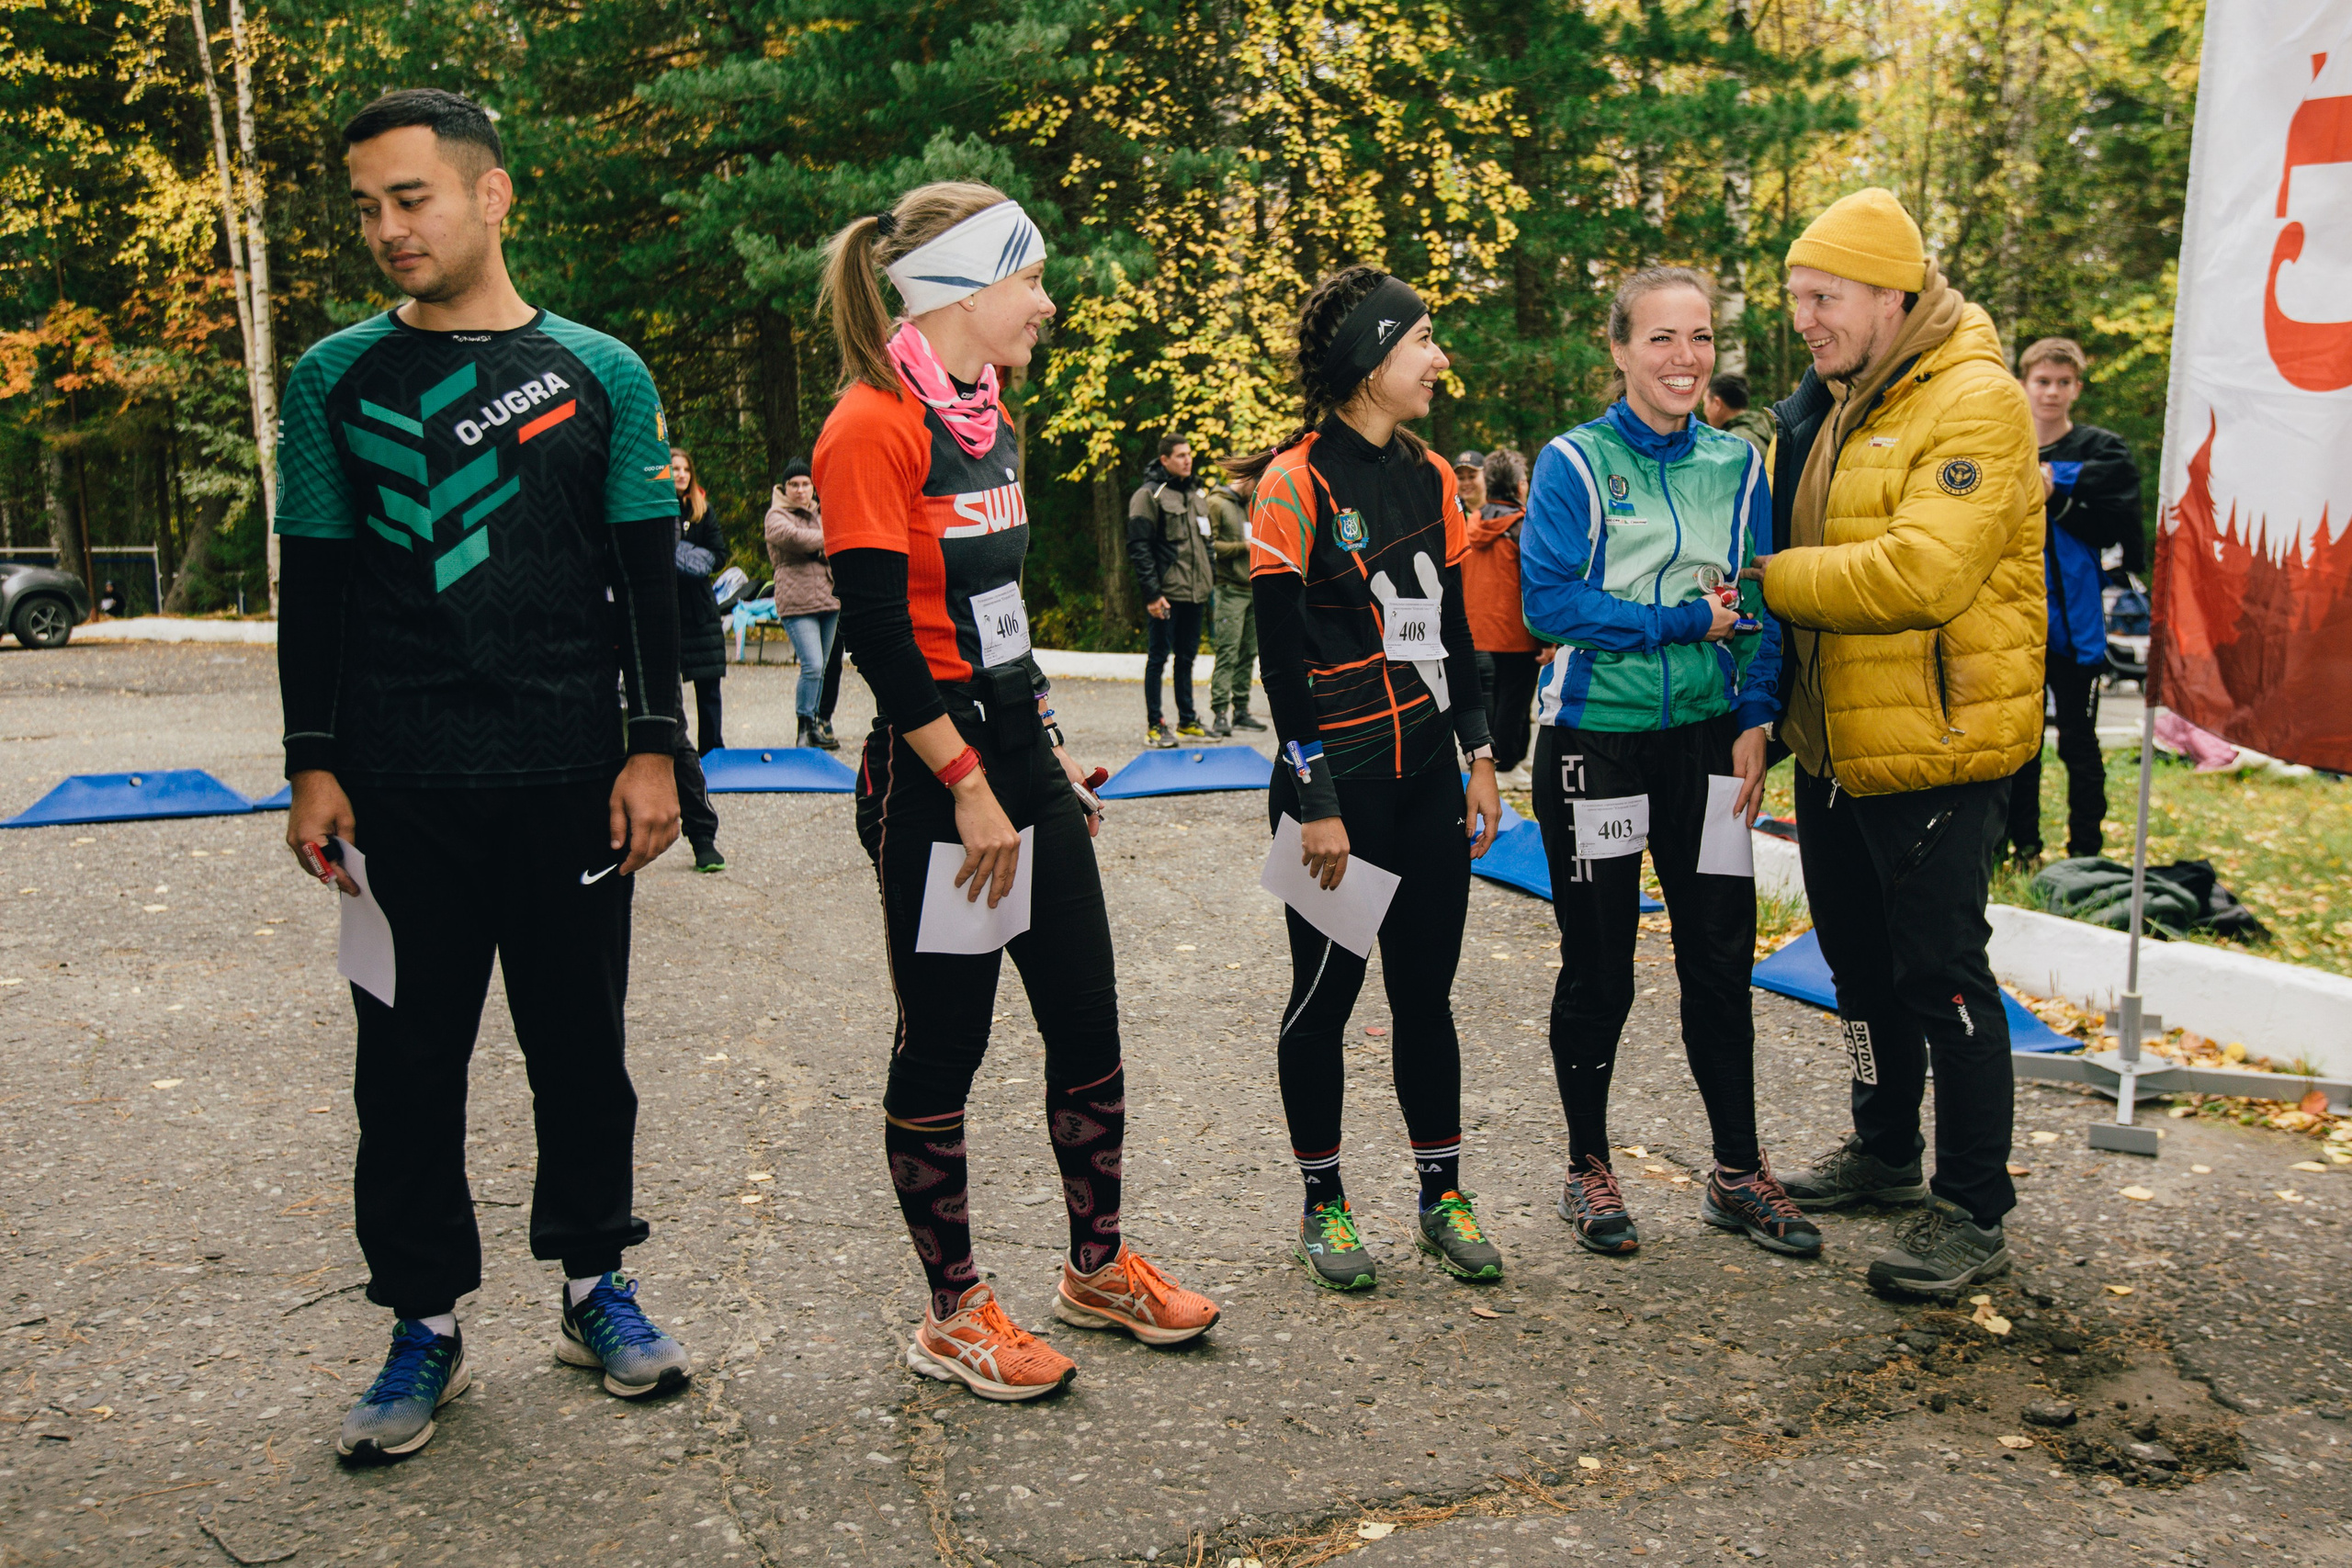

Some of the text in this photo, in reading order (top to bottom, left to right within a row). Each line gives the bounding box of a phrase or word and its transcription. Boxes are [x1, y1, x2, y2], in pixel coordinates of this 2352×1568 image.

[455, 371, 571, 446] O-UGRA
[996, 611, 1019, 638] 406
[1399, 622, 1426, 641] 408
[1598, 819, 1633, 840] 403
[1957, 1004, 1975, 1036] Reebok
